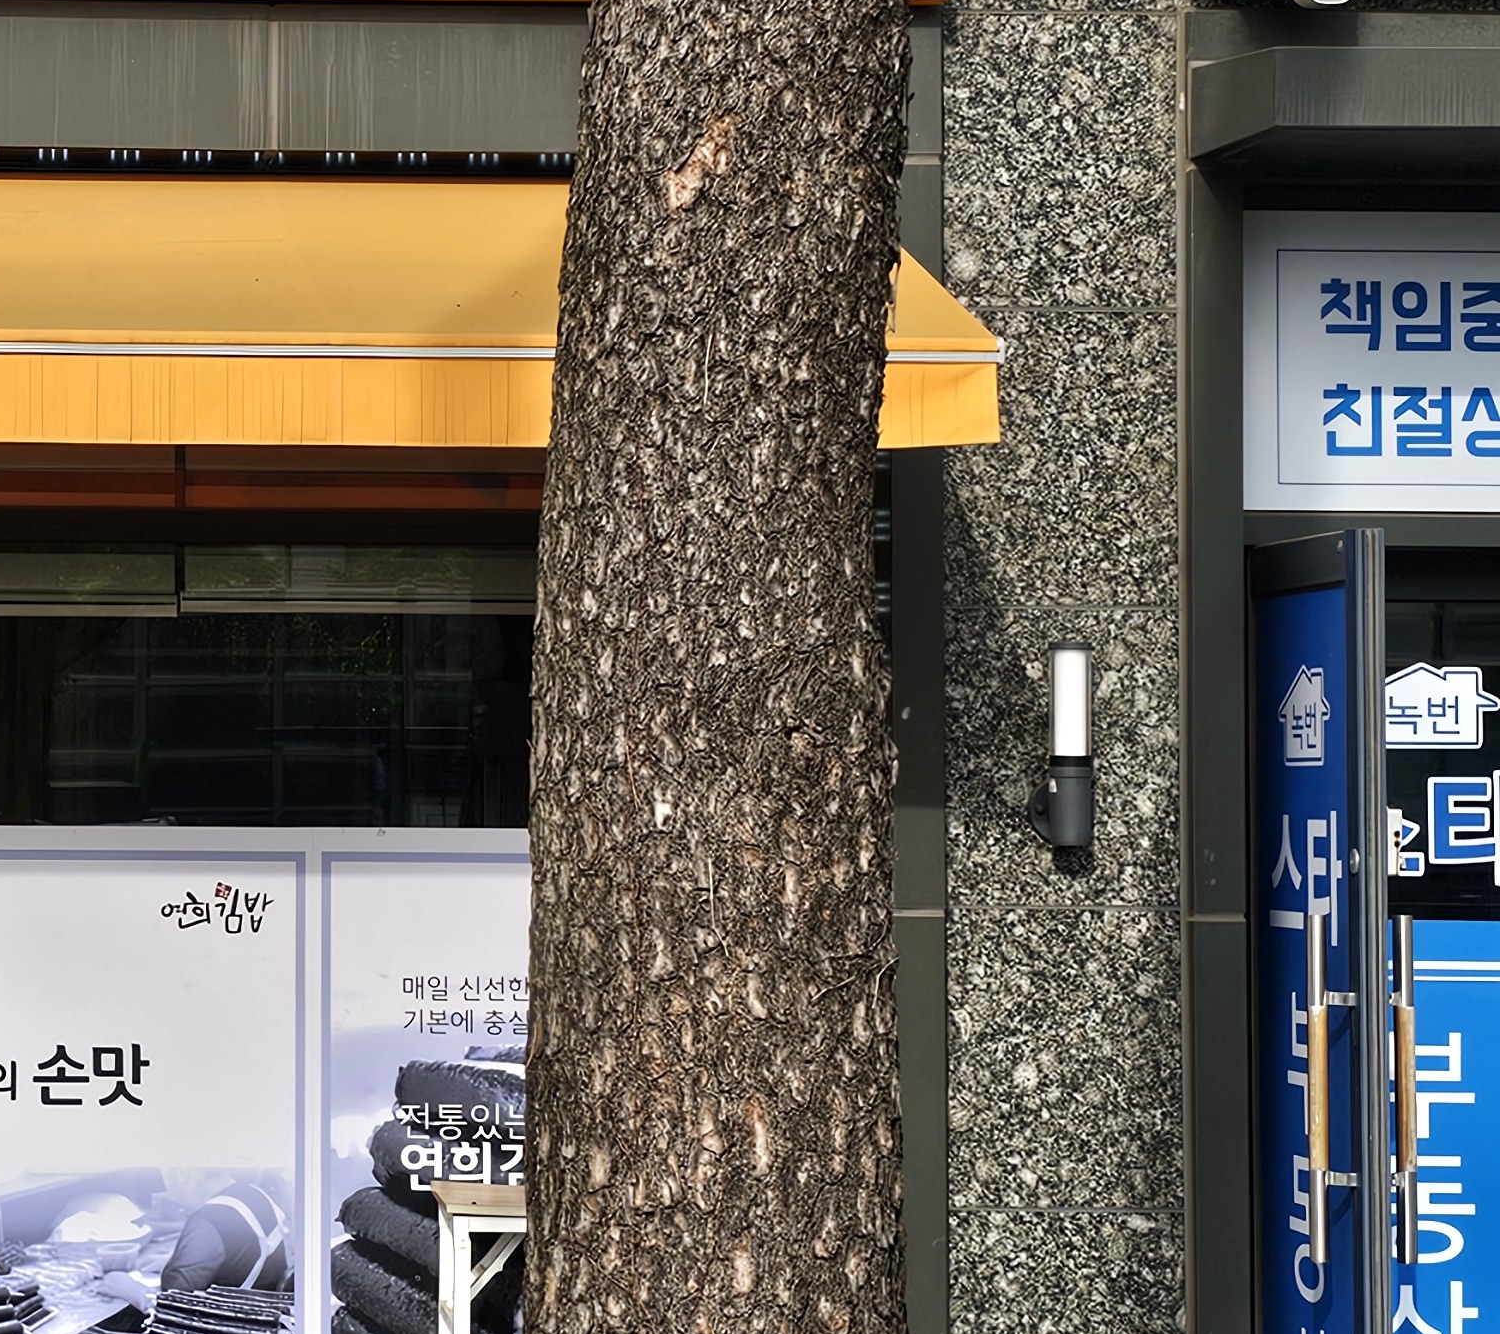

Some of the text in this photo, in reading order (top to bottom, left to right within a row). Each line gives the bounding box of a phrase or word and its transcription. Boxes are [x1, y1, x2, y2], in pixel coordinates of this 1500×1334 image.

[1386, 696, 1460, 735] 녹번
[214, 888, 274, 934] 김밥
[402, 975, 448, 1002] 매일
[402, 1009, 474, 1034] 기본에
[32, 1042, 151, 1107] 손맛
